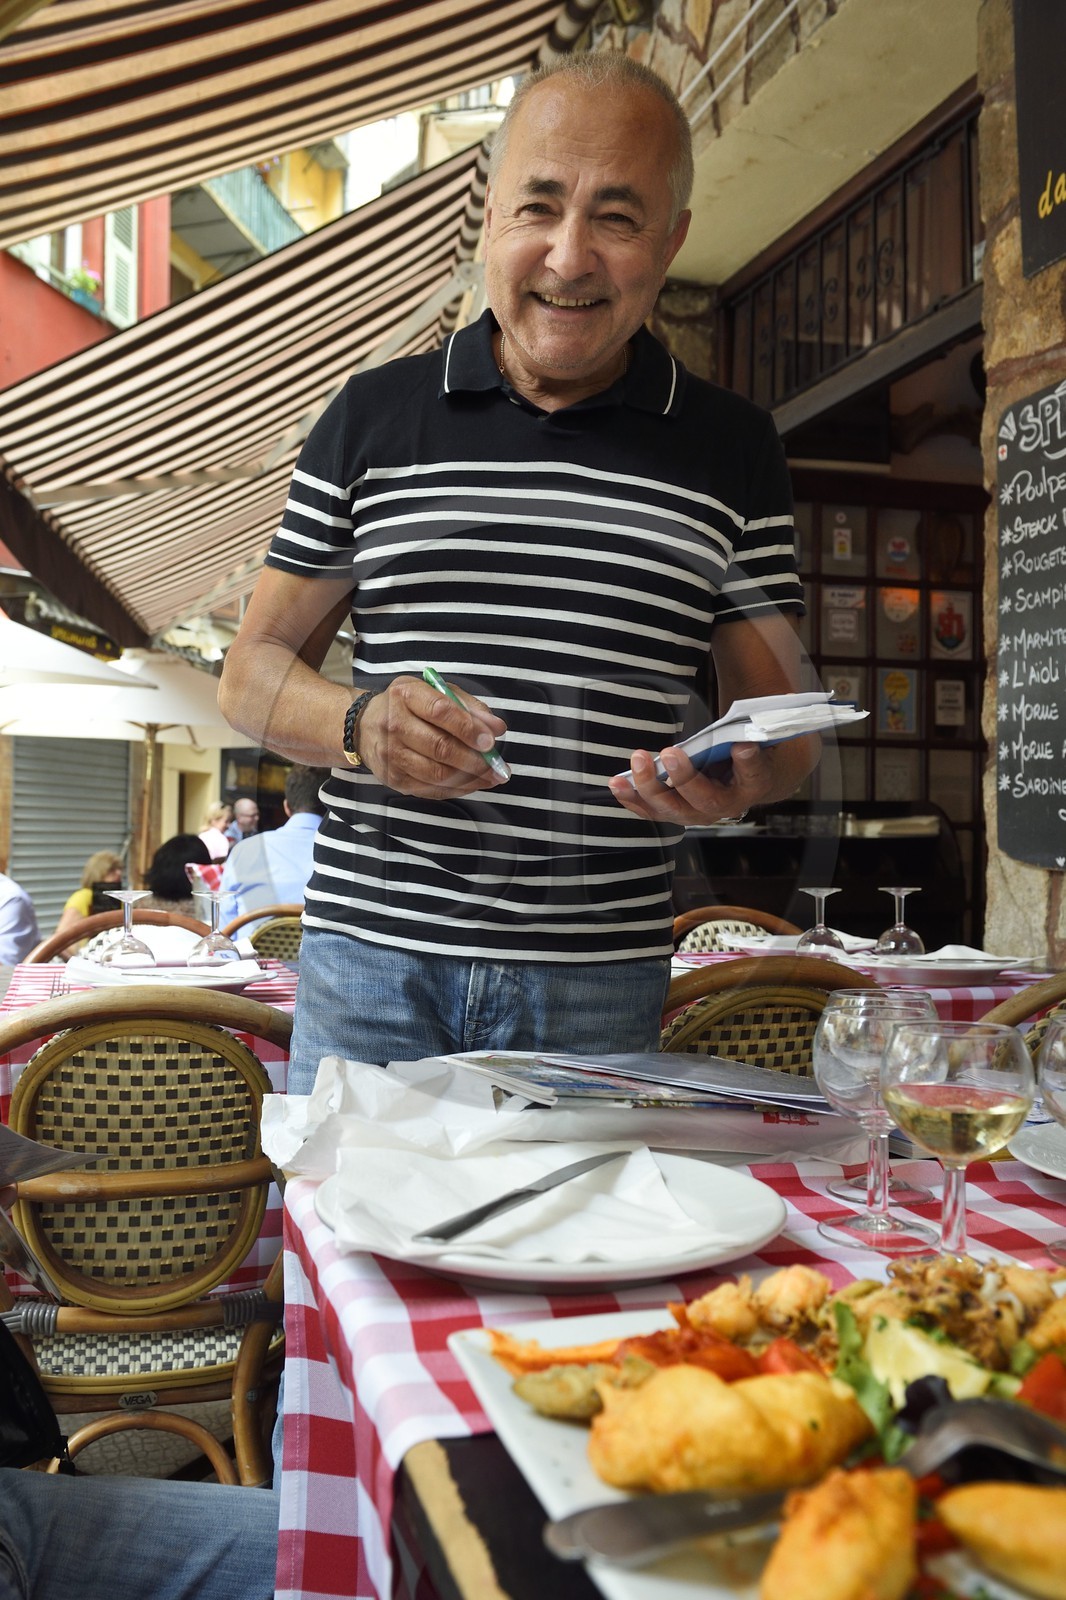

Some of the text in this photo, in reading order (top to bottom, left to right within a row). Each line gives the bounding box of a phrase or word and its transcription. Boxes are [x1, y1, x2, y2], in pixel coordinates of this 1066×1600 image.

[1012, 513, 1059, 544] STEACK
[1015, 582, 1066, 612] SCAMPi
[124, 1394, 153, 1406] VEGA
